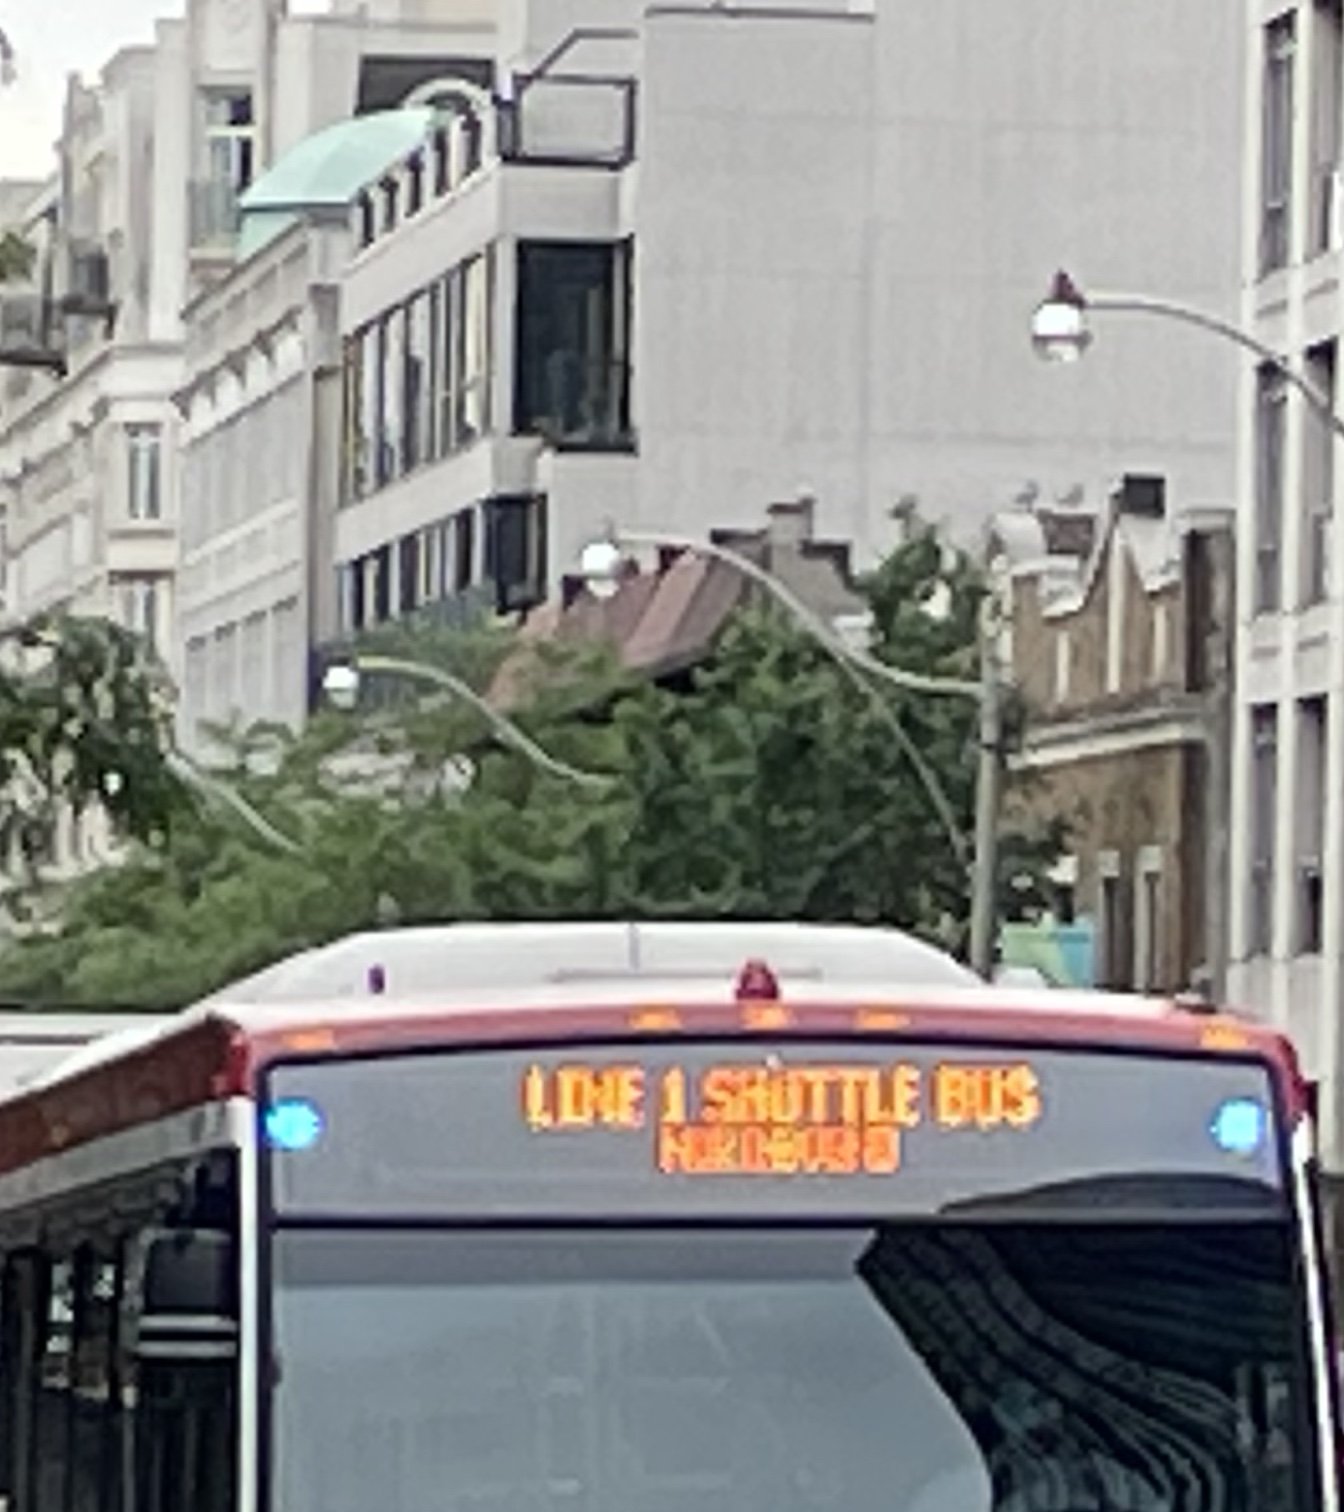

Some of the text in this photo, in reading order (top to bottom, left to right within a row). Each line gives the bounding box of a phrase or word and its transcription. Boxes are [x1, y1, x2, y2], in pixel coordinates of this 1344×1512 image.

[522, 1064, 1042, 1131] LINE 1 SHUTTLE BUS
